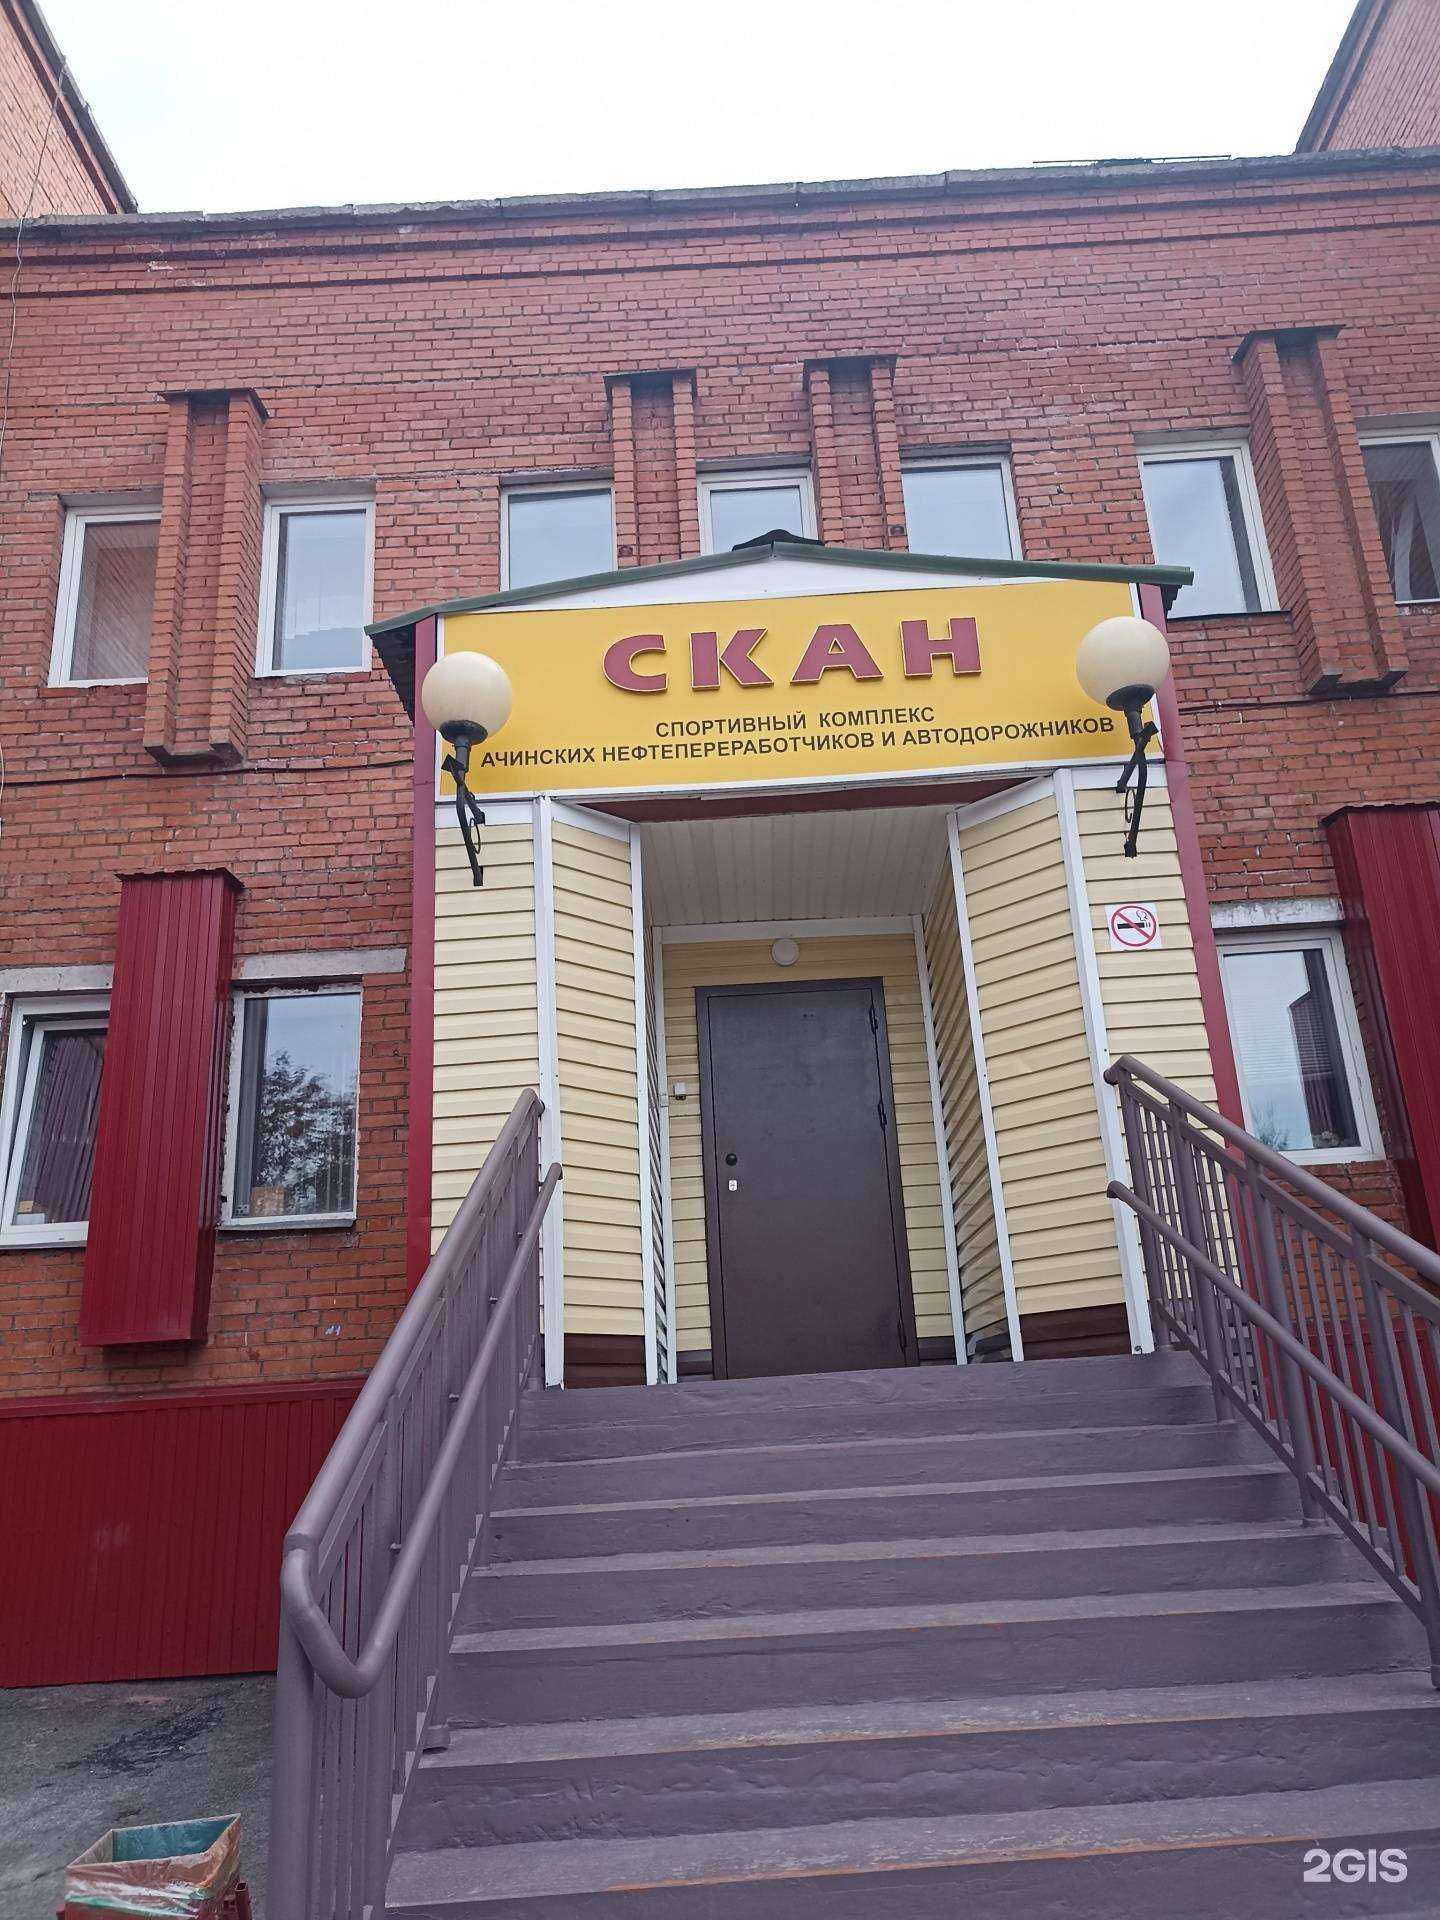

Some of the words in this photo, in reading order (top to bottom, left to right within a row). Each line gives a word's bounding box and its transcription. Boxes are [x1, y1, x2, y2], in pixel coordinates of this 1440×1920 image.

[603, 616, 983, 693] СКАН
[480, 747, 596, 768] АЧИНСКИХ
[602, 732, 875, 763] НЕФТЕПЕРЕРАБОТЧИКОВ
[881, 731, 896, 747] И
[902, 716, 1115, 746] АВТОДОРОЖНИКОВ
[655, 710, 807, 738] СПОРТИВНЫЙ
[819, 706, 935, 728] КОМПЛЕКС
